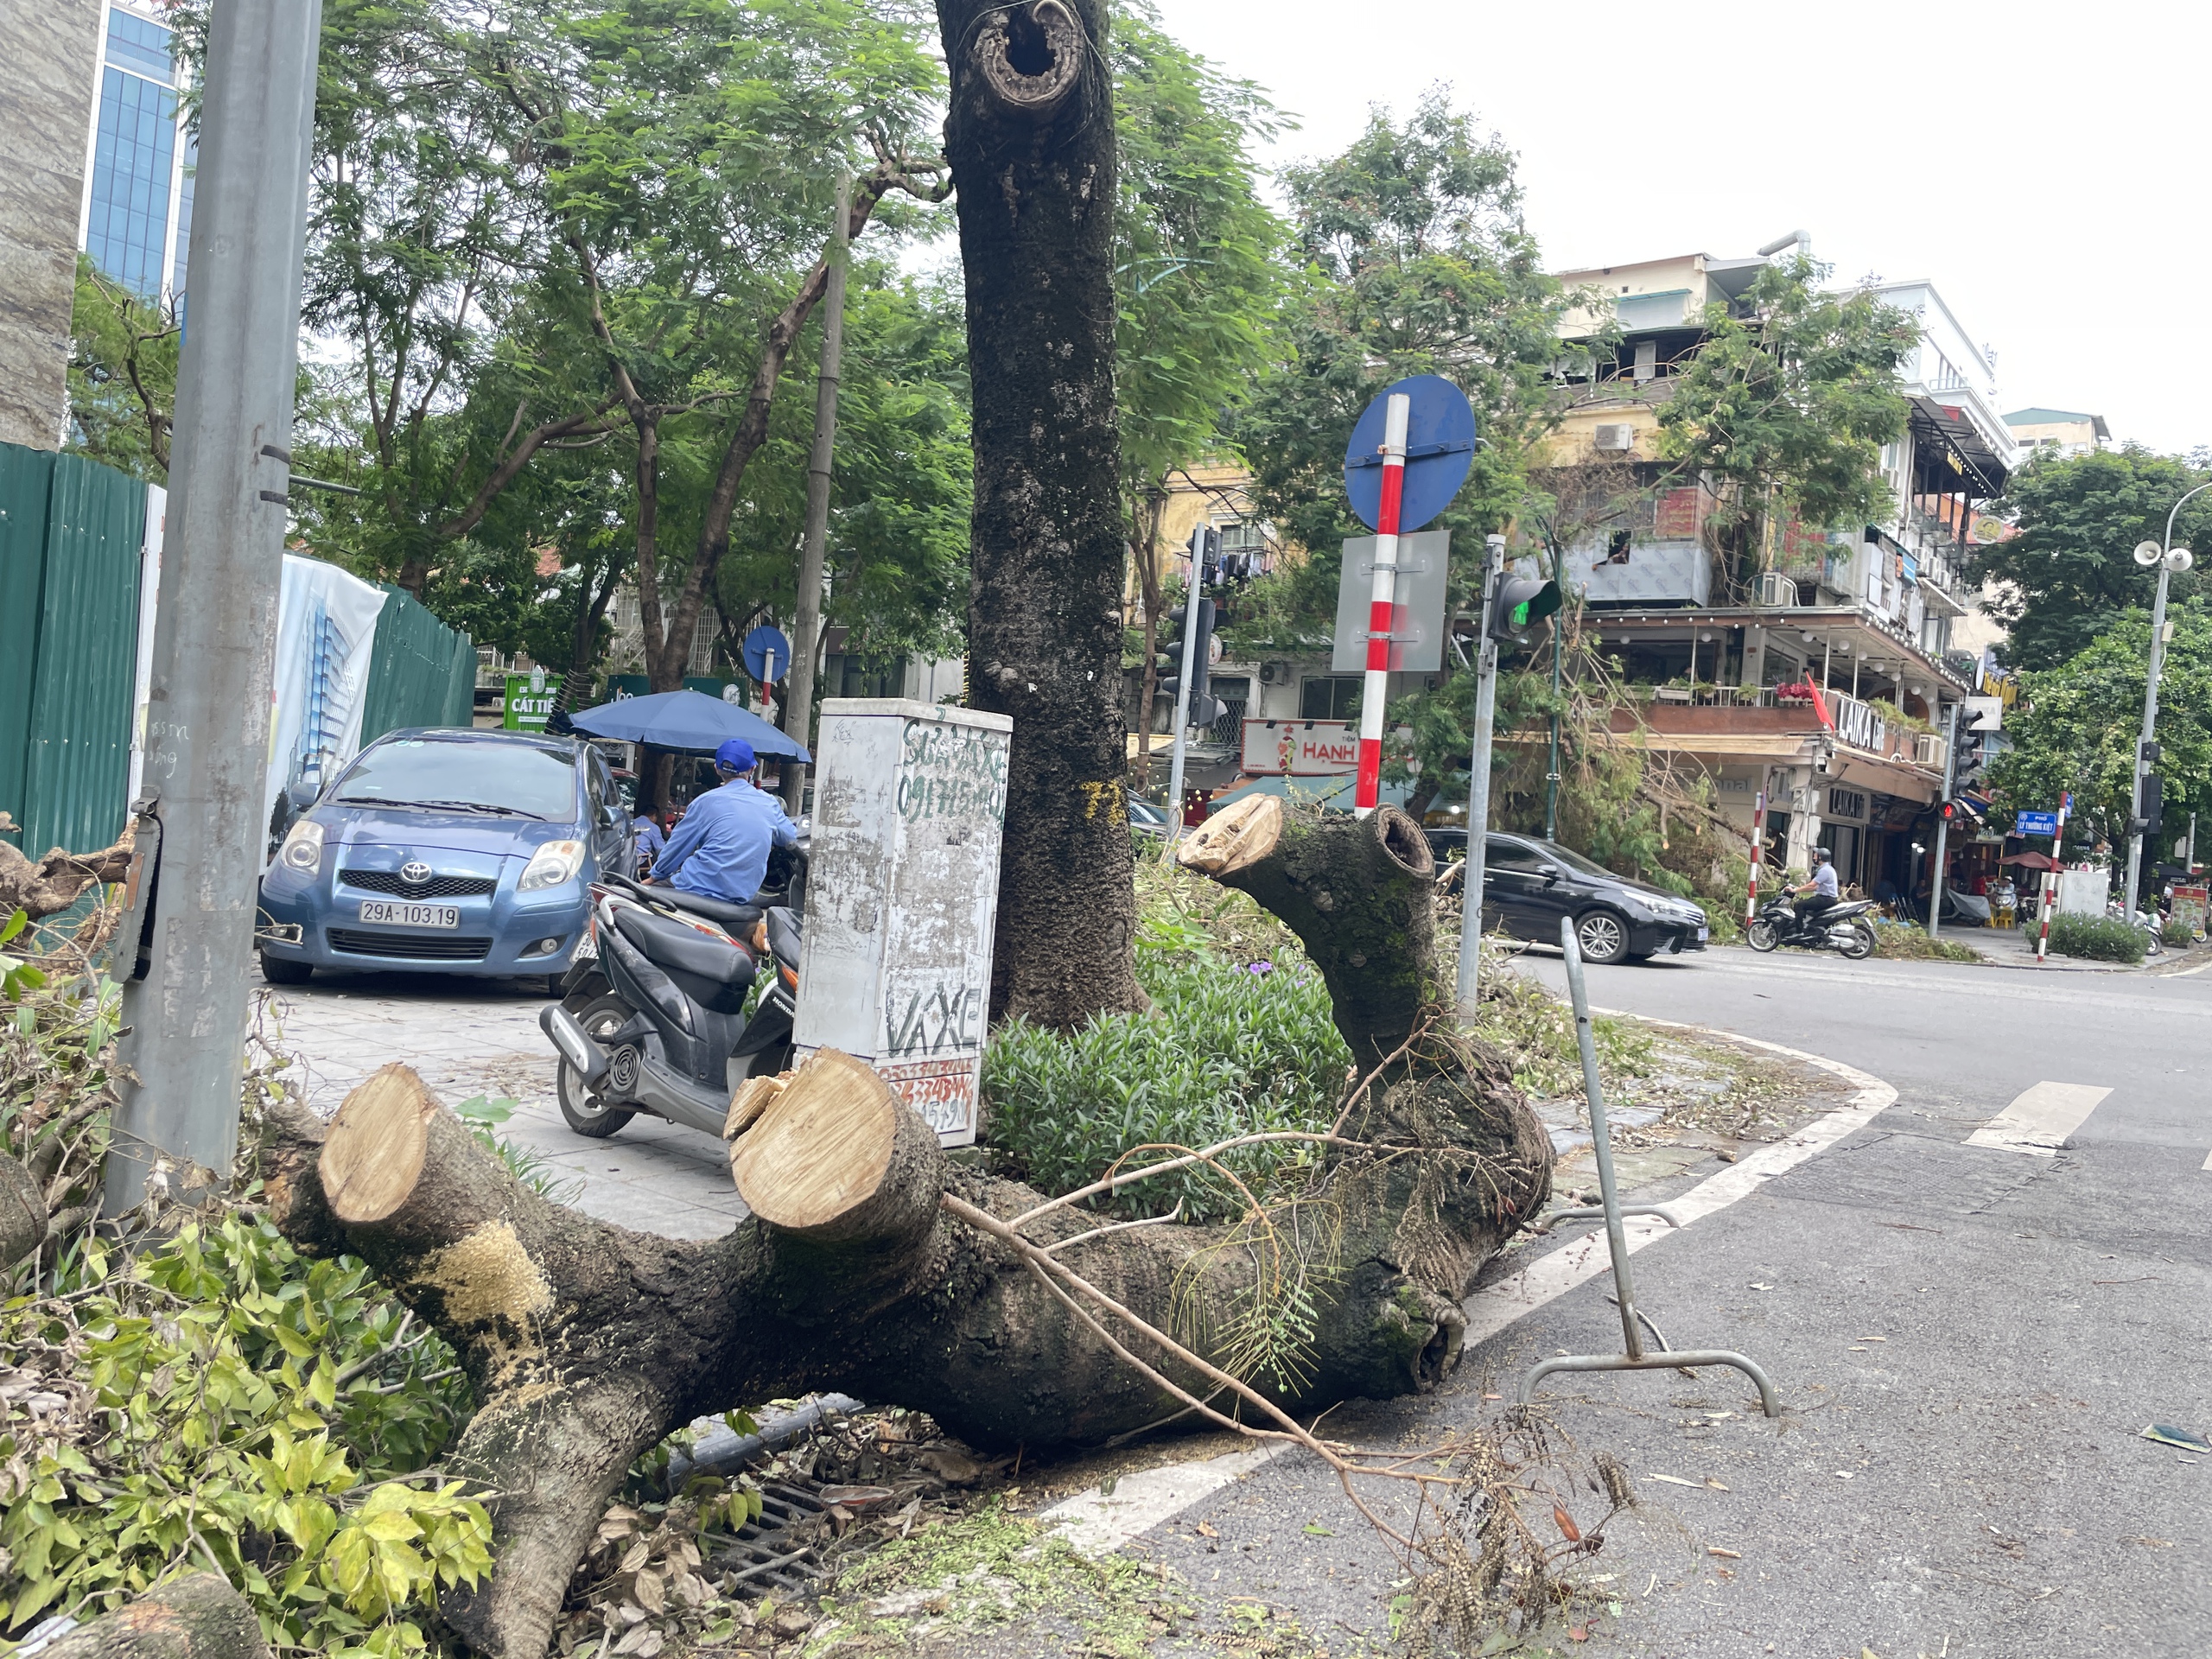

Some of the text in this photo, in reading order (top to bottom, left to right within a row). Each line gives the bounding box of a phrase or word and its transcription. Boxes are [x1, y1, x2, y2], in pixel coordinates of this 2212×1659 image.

[512, 696, 535, 713] CÁT
[1838, 697, 1872, 749] LAIKA
[1303, 741, 1356, 764] HẠNH
[1833, 787, 1855, 817] LAIKA
[363, 902, 456, 925] 29A-103.19
[772, 995, 795, 1019] HONDA
